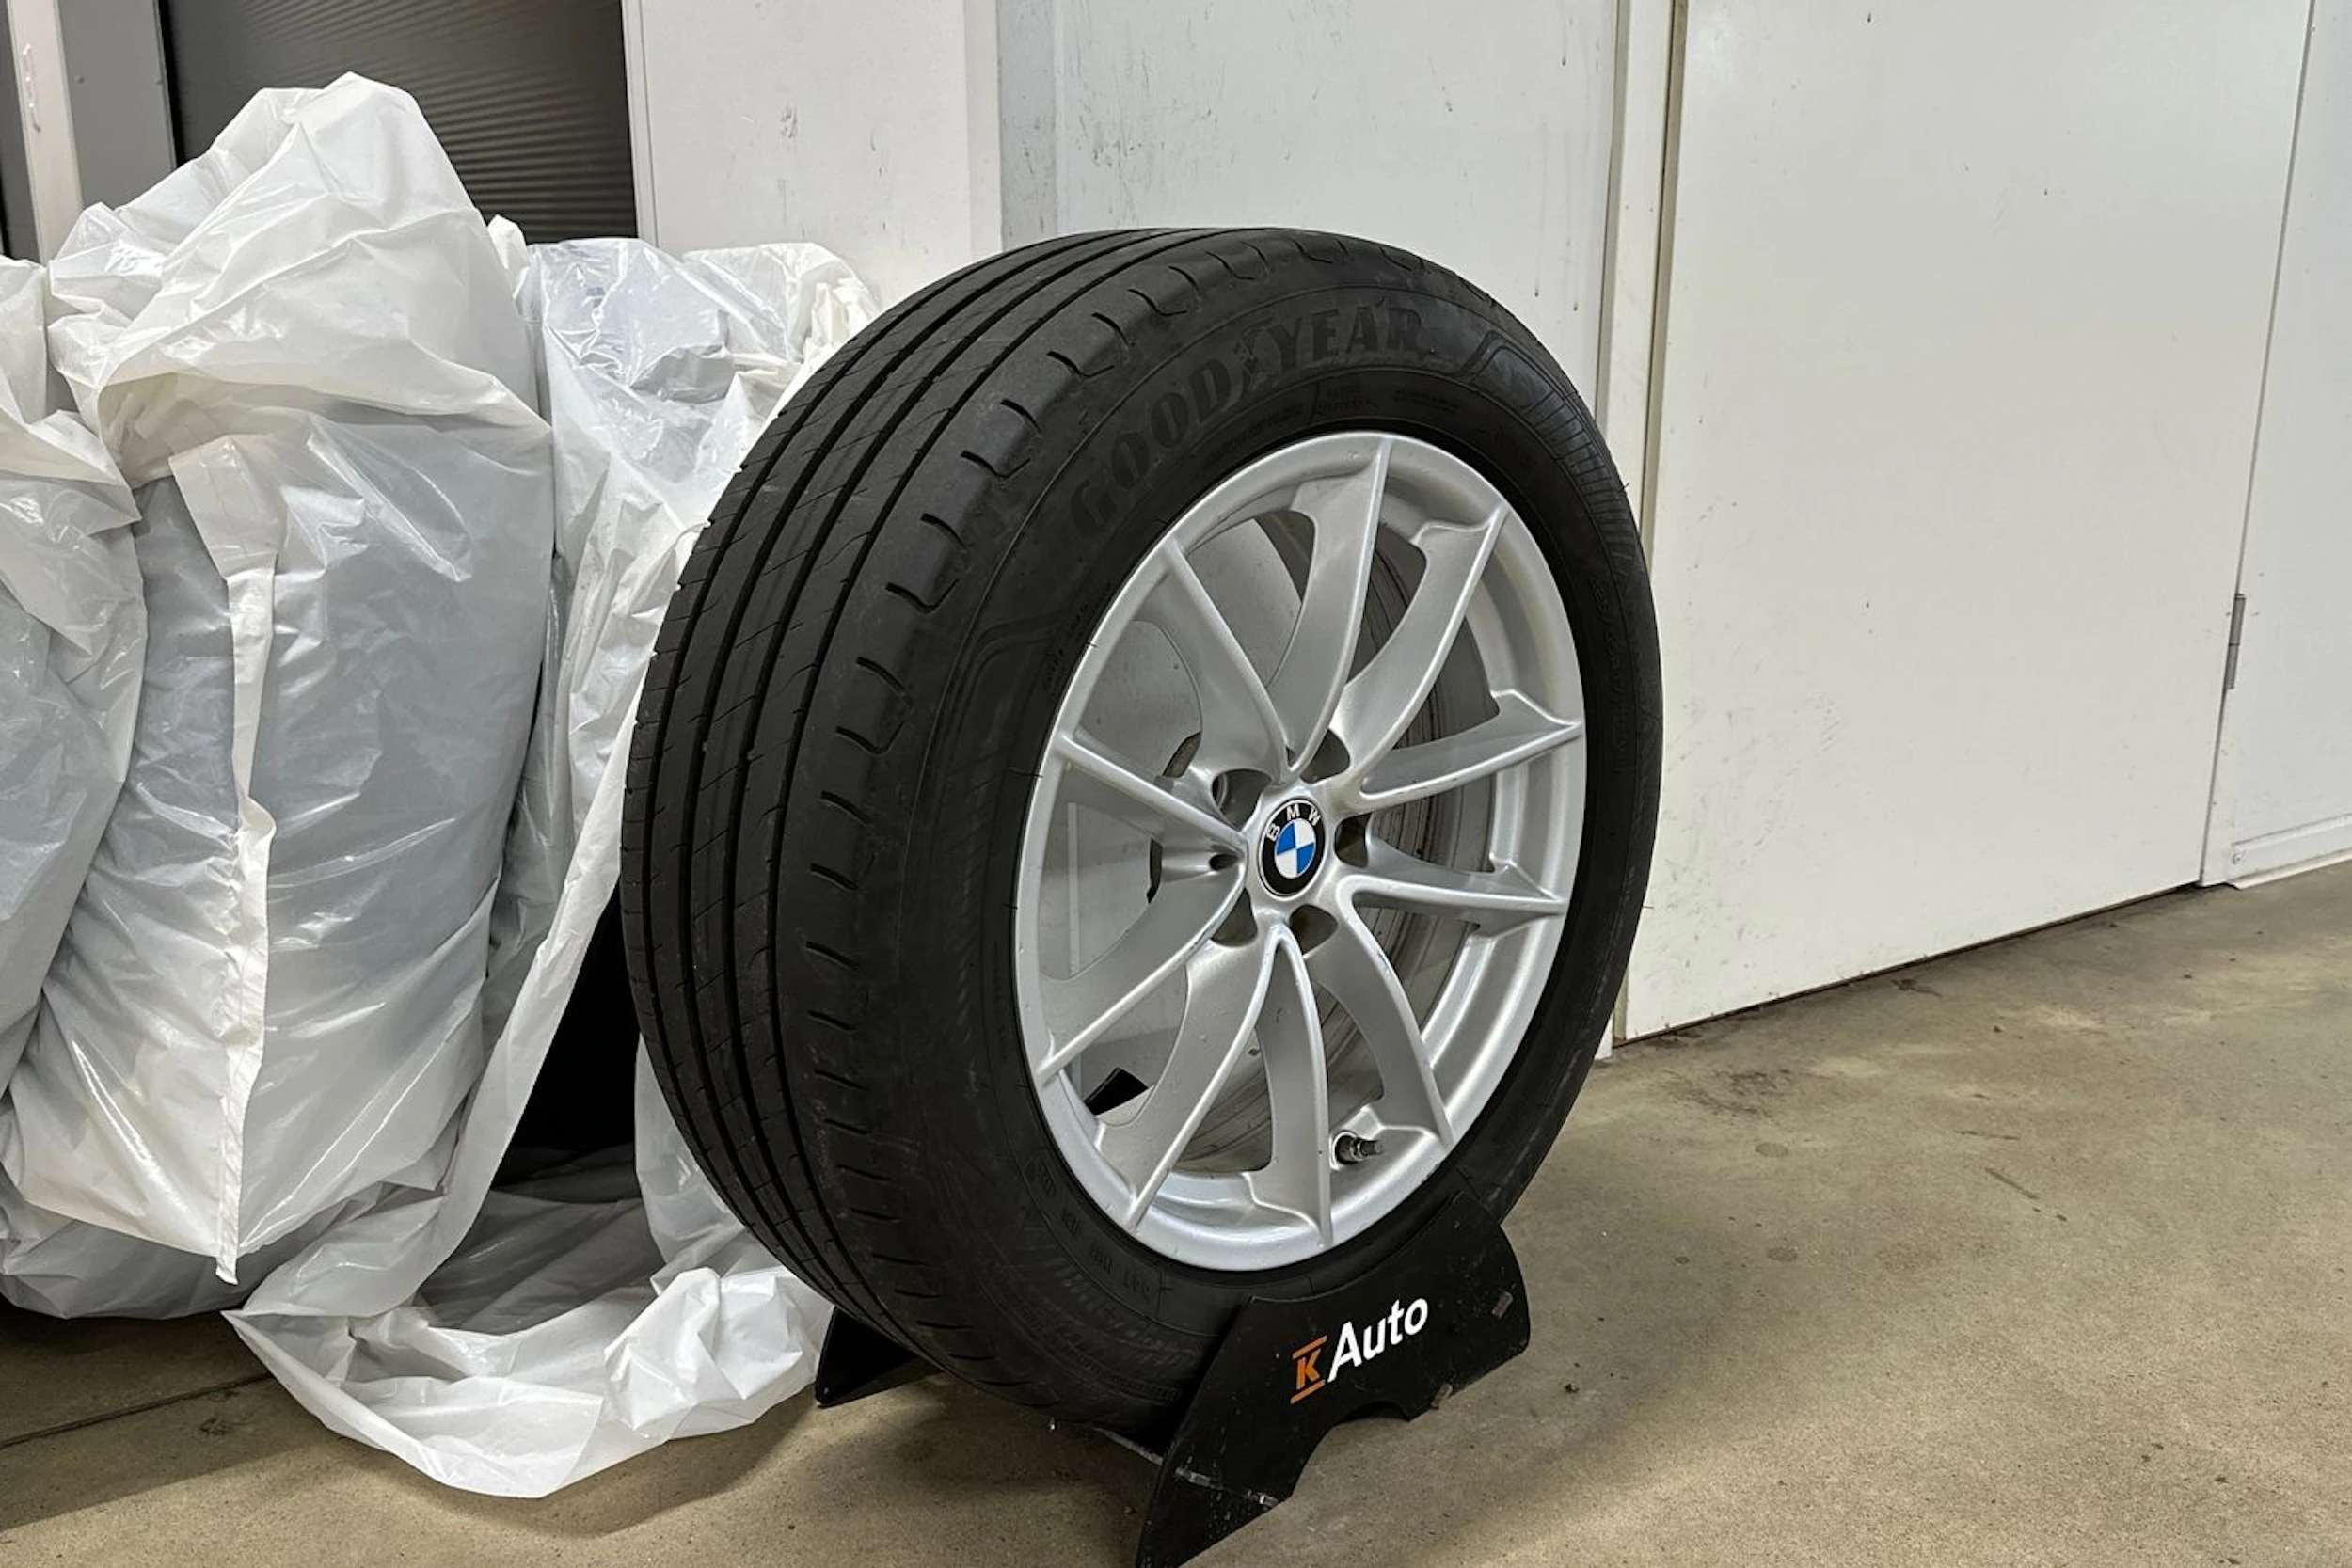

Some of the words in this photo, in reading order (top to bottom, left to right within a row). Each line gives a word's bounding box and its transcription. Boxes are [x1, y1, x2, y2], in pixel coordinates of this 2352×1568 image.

[1070, 305, 1434, 539] GOODYEAR
[1265, 803, 1322, 842] BMW
[1327, 1297, 1429, 1383] Auto
